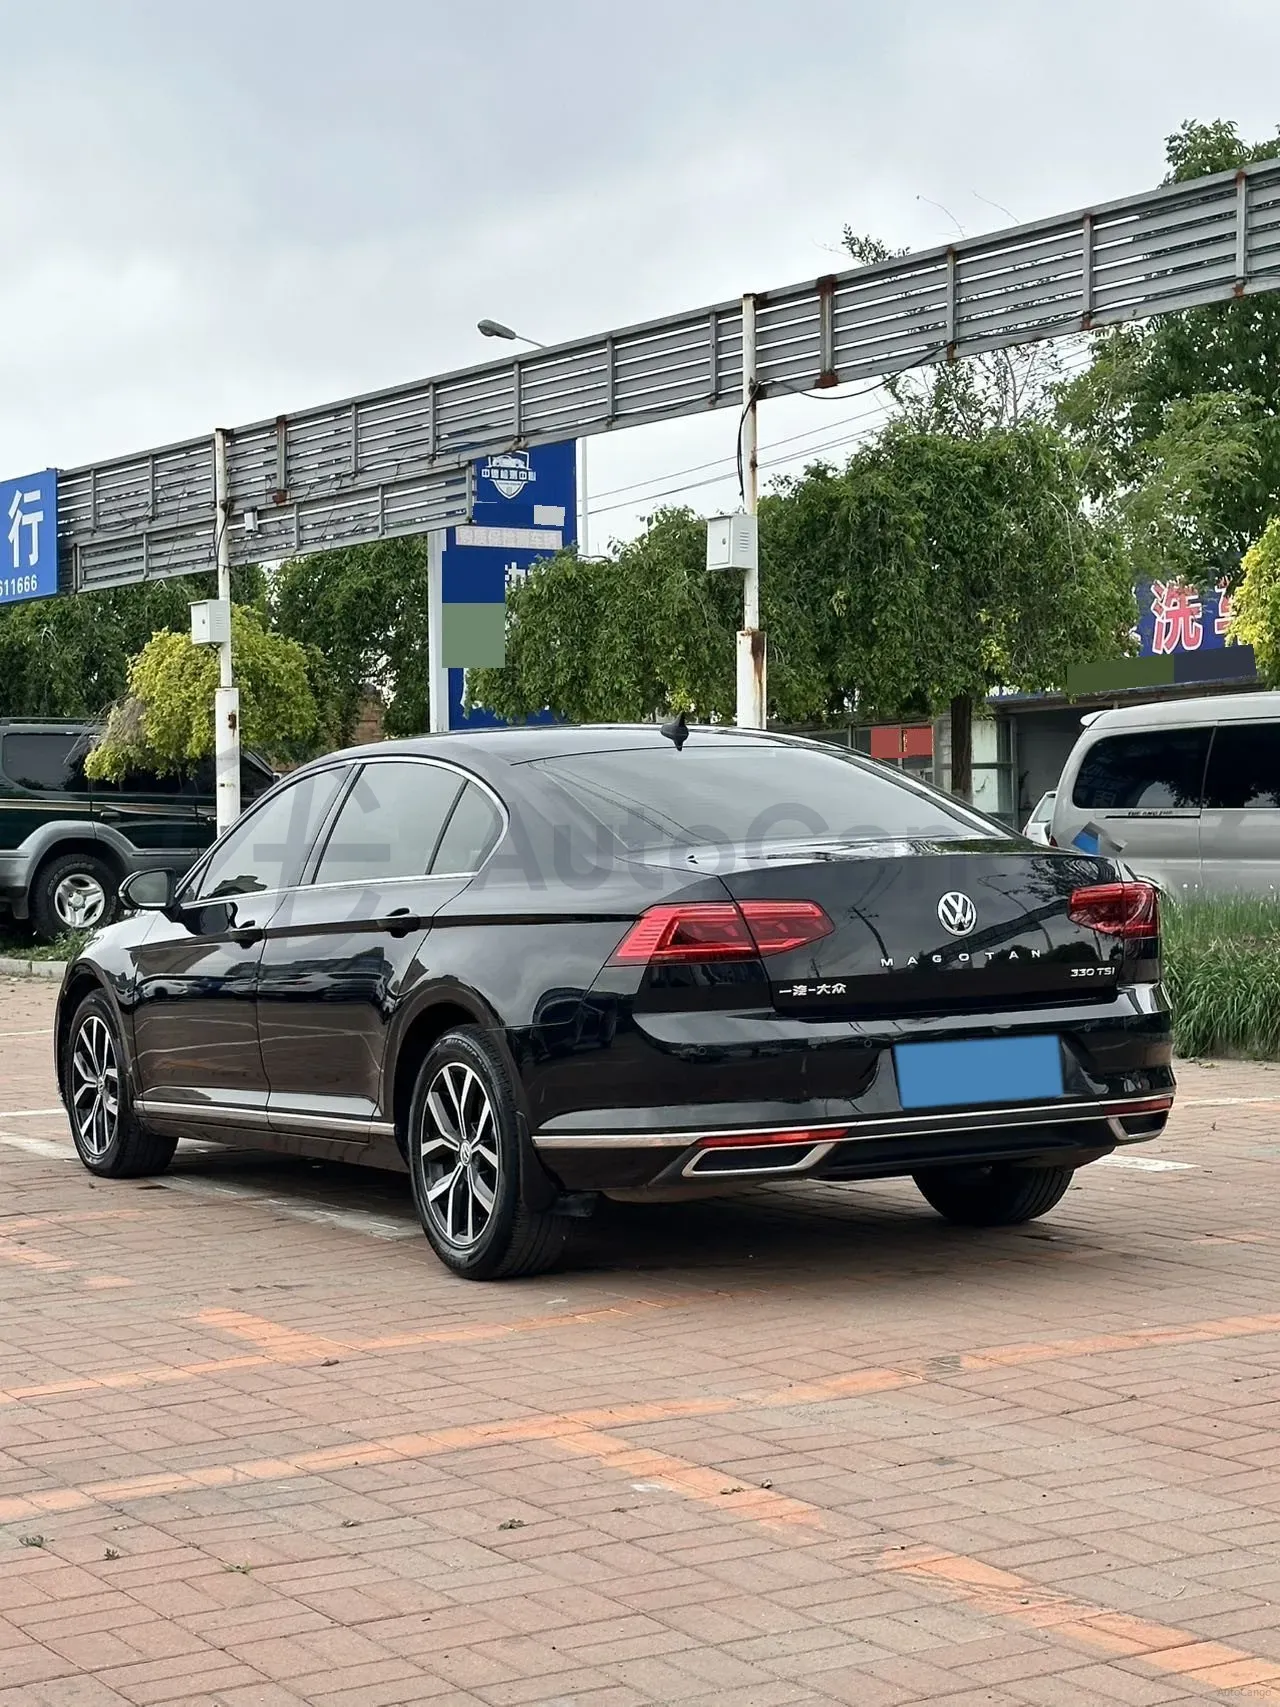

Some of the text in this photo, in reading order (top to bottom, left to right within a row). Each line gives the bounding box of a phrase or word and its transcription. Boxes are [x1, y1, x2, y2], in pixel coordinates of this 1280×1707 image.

[8, 490, 44, 568] 行
[880, 949, 1041, 967] MAGOTAN
[1070, 966, 1115, 977] 330 TSI
